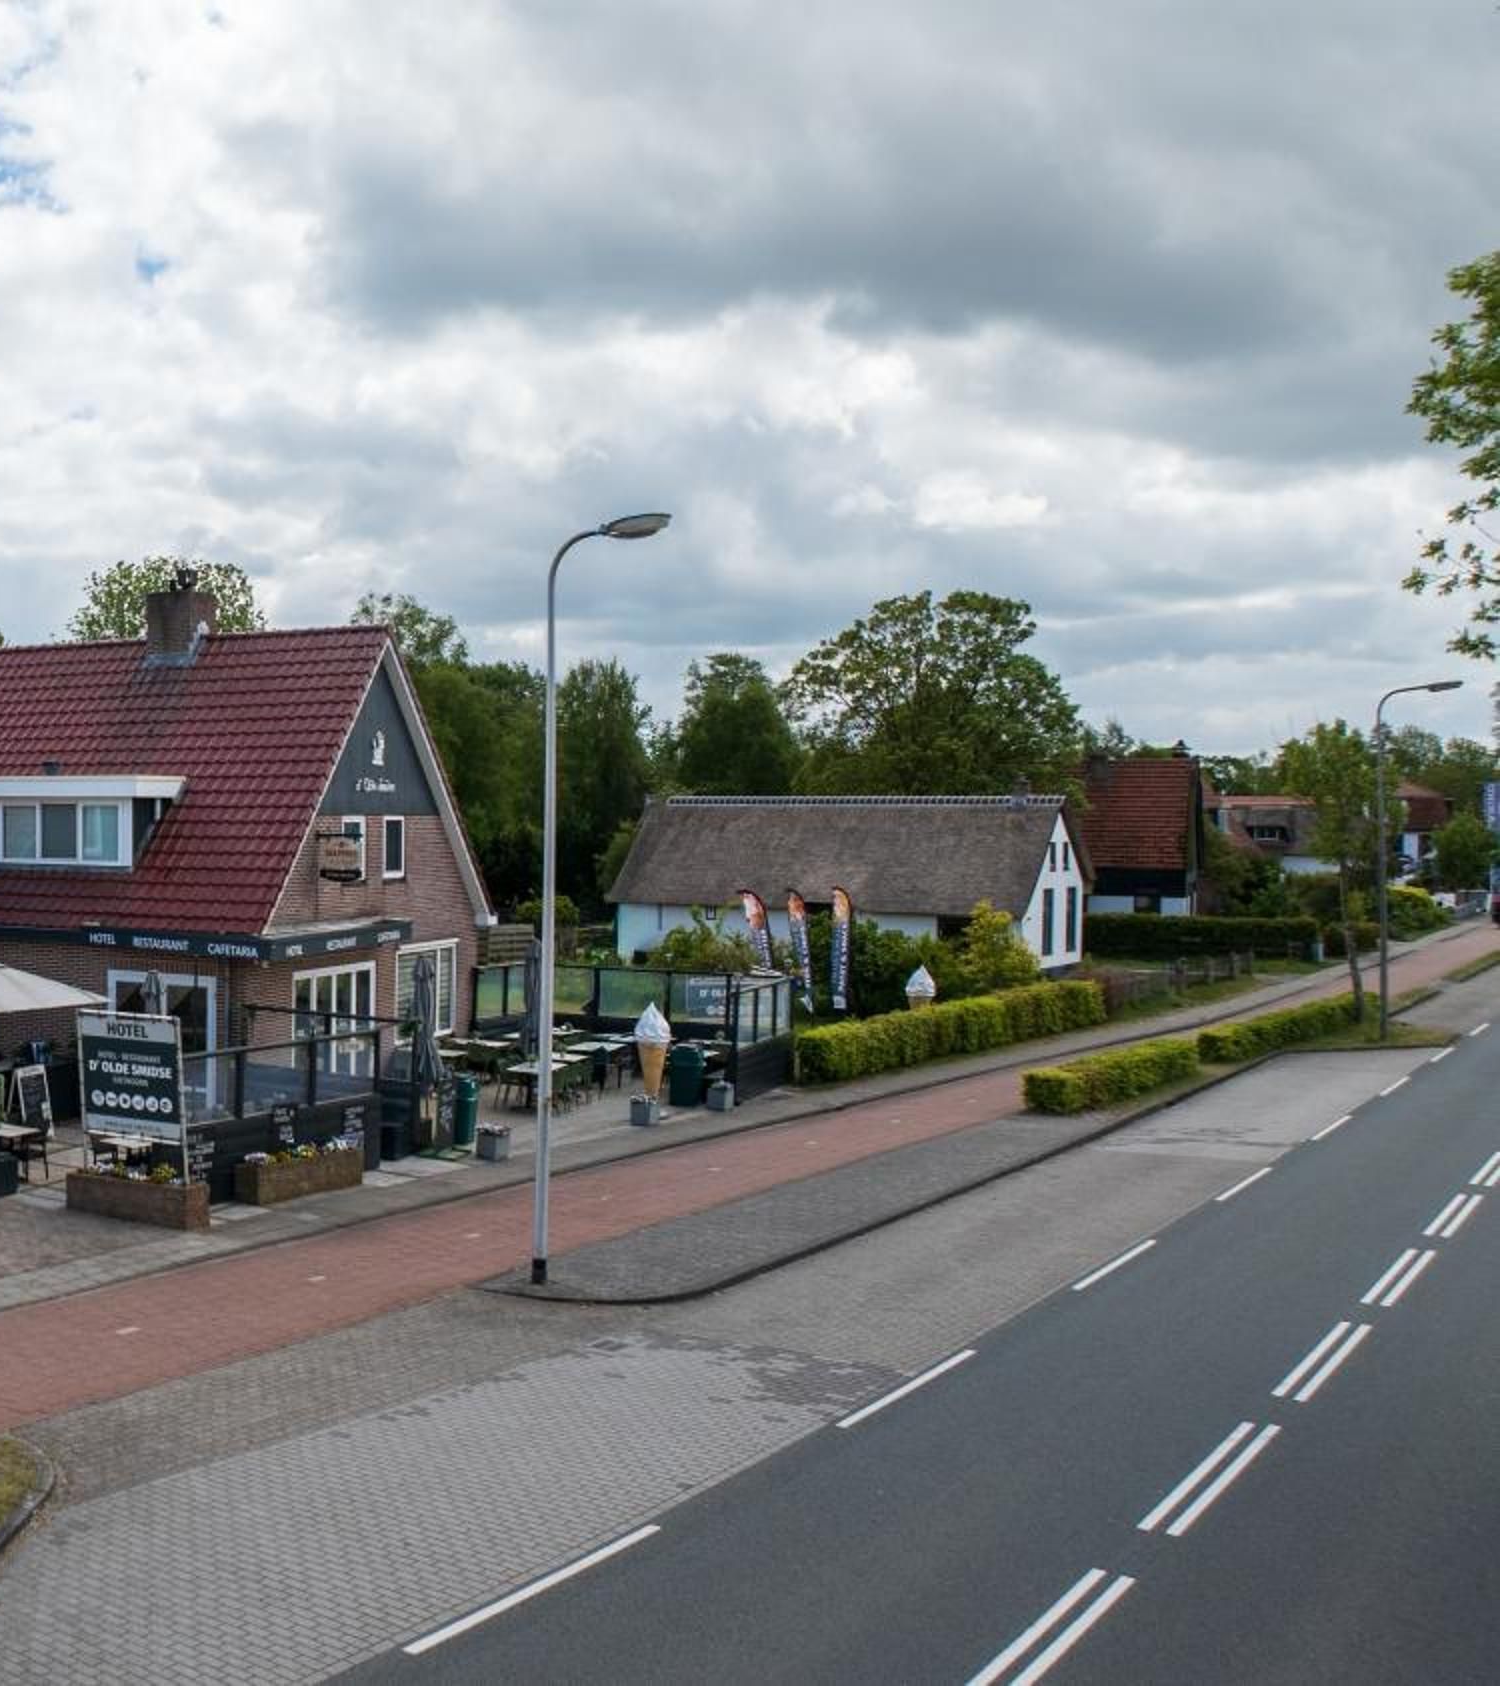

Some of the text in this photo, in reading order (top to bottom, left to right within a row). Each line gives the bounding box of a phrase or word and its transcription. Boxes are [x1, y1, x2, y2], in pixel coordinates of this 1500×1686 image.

[89, 933, 117, 945] HOTEL
[132, 936, 189, 951] RESTAURANT
[107, 1023, 149, 1039] HOTEL
[101, 1061, 130, 1075] OLDE
[131, 1064, 173, 1079] SMIDSE
